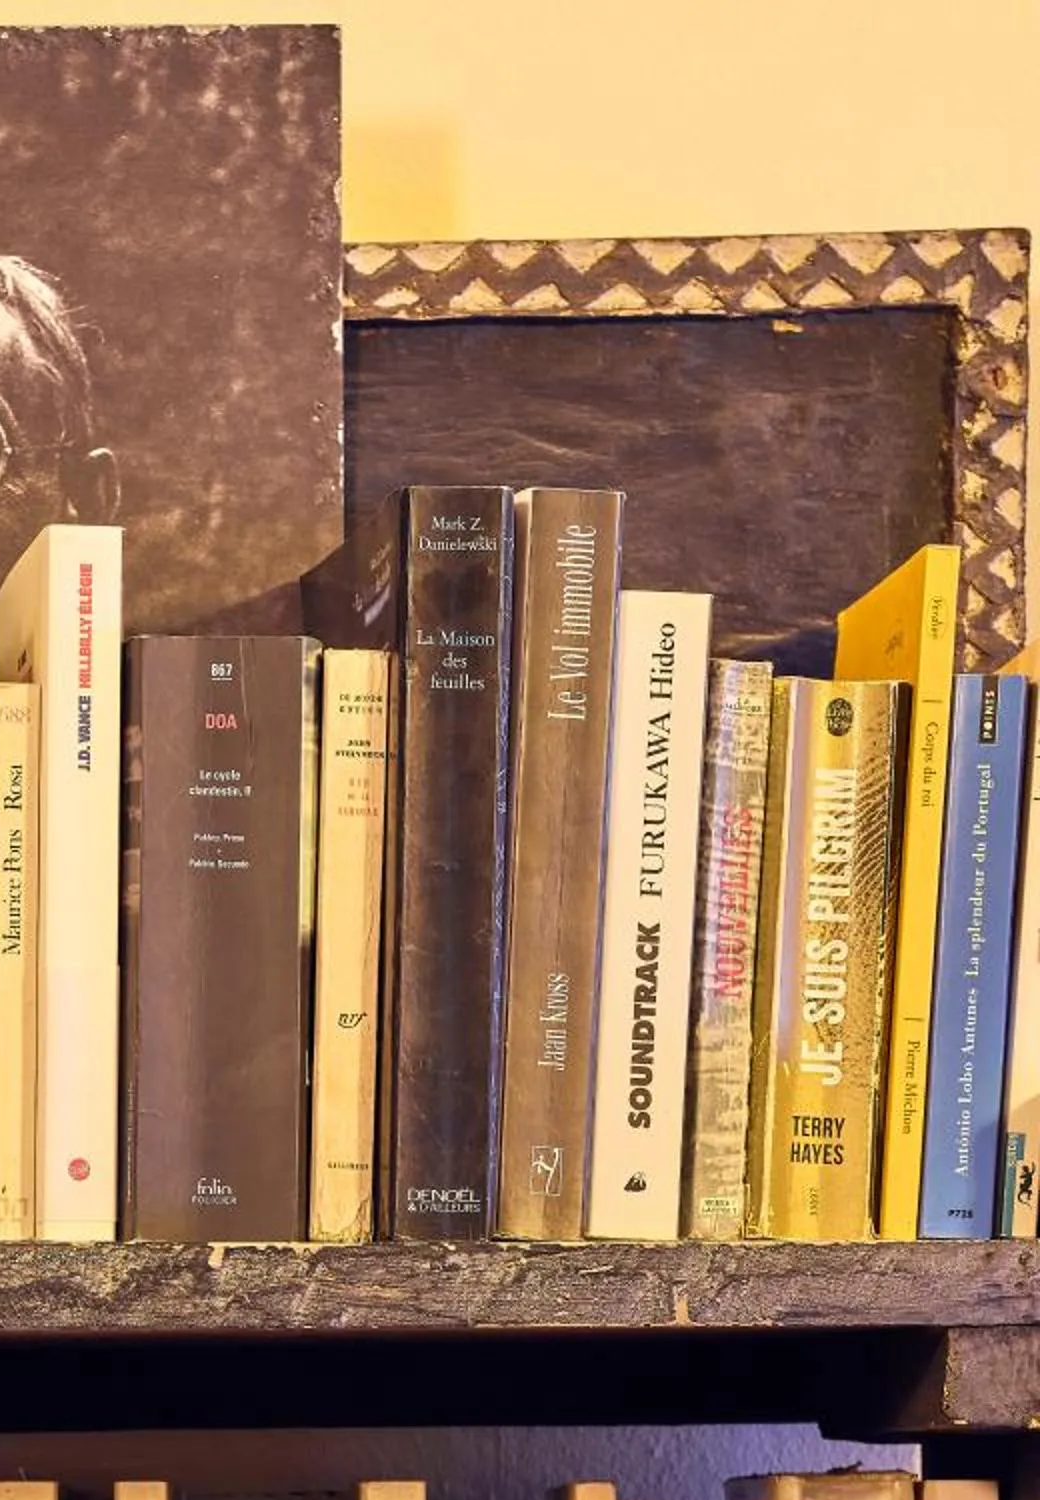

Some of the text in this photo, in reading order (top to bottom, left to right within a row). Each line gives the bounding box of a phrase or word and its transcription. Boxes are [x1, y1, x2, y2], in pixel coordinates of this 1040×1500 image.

[432, 517, 484, 530] Mark Z.
[419, 537, 497, 551] Danielewski
[416, 631, 495, 646] La Maison
[547, 524, 596, 721] Le Vol immobile
[76, 564, 93, 772] J.D. VANCE HILLBILLY ÉLÉGIE
[211, 664, 232, 676] 867
[443, 654, 467, 669] des
[431, 674, 485, 690] feuilles
[205, 714, 237, 729] DOA
[982, 689, 996, 739] POINTS
[2, 764, 22, 955] Maurice Pons Rosa
[628, 622, 678, 1128] SOUNDTRACK FURUKAWA Hideo
[711, 806, 753, 1000] NOUVELLES
[799, 767, 857, 1086] JE SUIS PILGRIM
[954, 763, 994, 1176] António Lobo Antunes La splendeur du Portugal
[538, 973, 569, 1071] Jaan Kross
[792, 1116, 846, 1139] TERRY
[791, 1144, 843, 1165] HAYES
